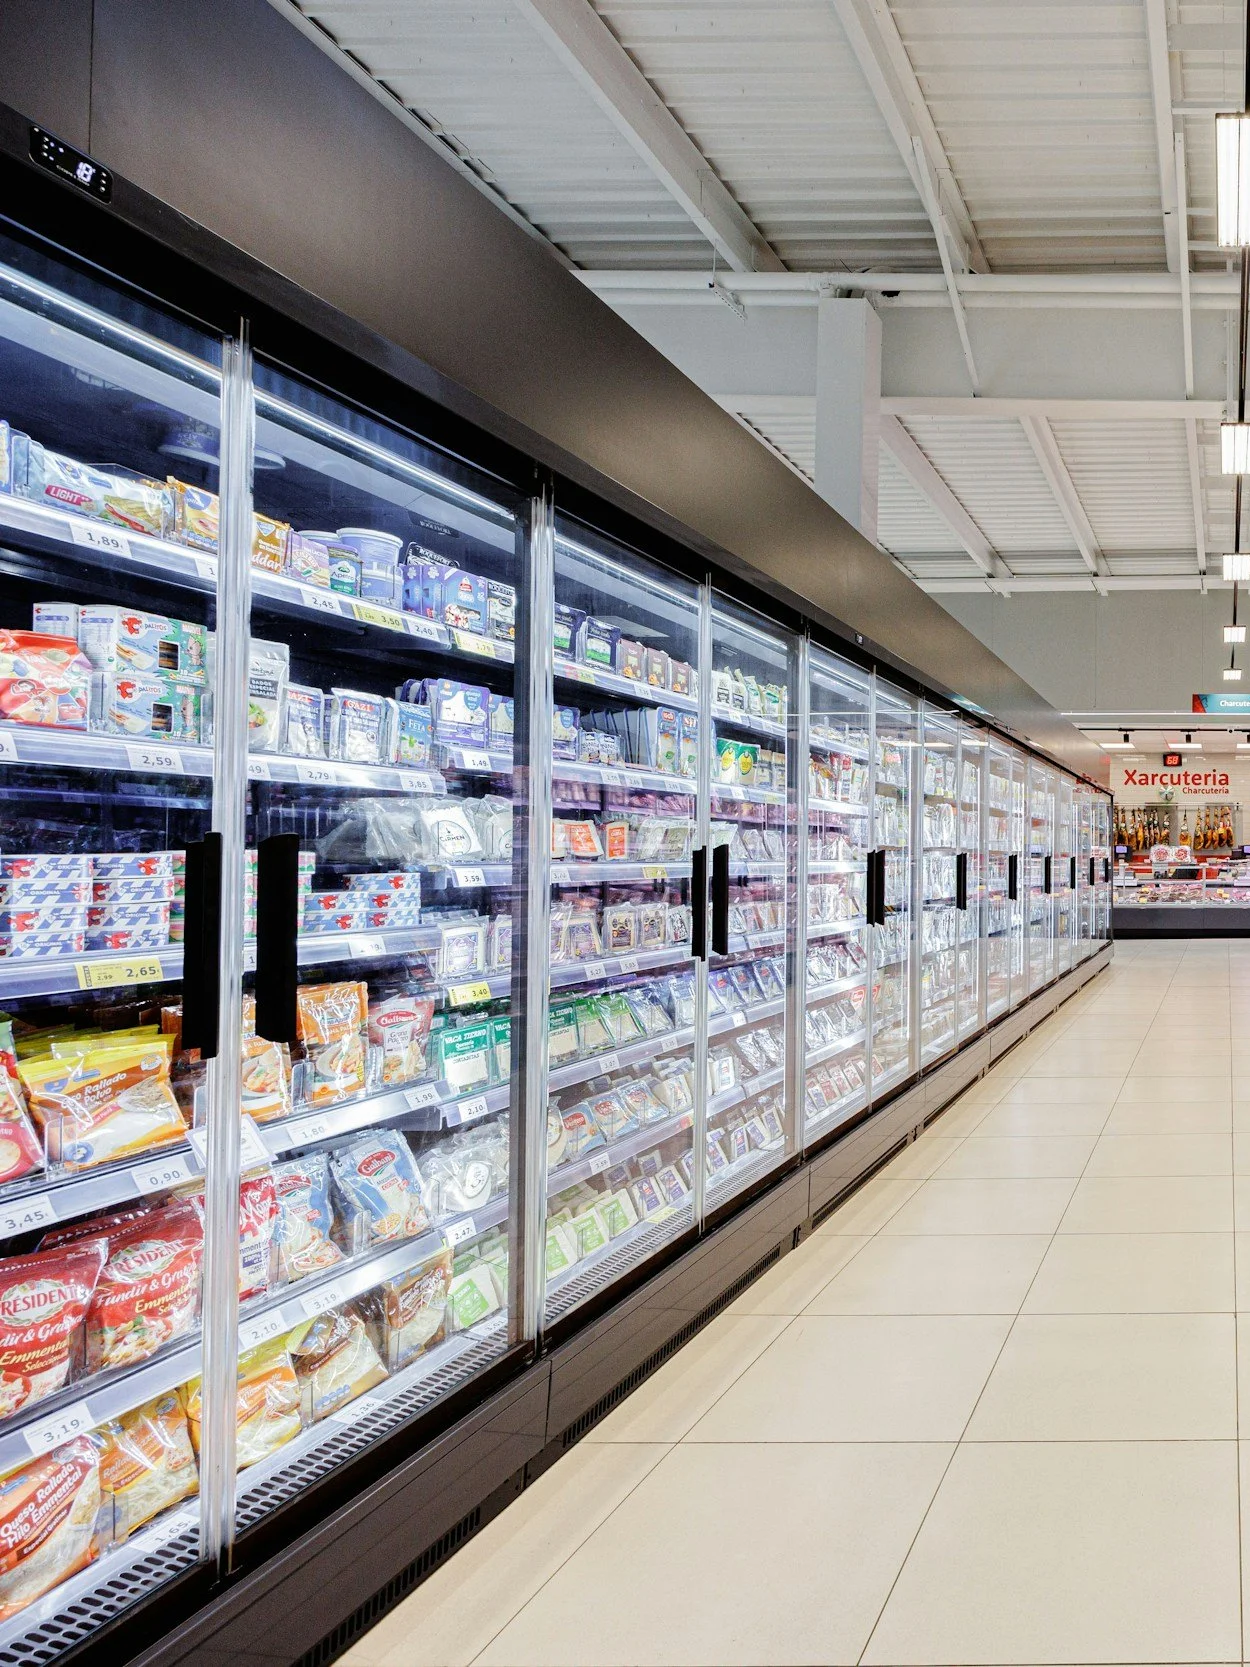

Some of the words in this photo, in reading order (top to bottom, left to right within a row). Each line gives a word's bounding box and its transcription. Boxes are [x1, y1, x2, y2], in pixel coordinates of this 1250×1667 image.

[50, 486, 80, 504] LIGHT
[408, 719, 425, 732] FETA
[1166, 756, 1179, 765] 68
[1124, 769, 1229, 786] Xarcuteria
[1182, 787, 1229, 795] Charcutería
[84, 1072, 127, 1095] Rallado
[83, 1087, 112, 1106] Polvo
[361, 1155, 394, 1173] Galbani
[0, 1285, 77, 1316] RÉSIDENT
[97, 1282, 147, 1308] Fundir
[149, 1279, 159, 1291] &
[22, 1329, 36, 1343] &
[6, 1521, 30, 1550] Hilo
[31, 1469, 83, 1524] Emmental
[0, 1503, 35, 1538] Queso
